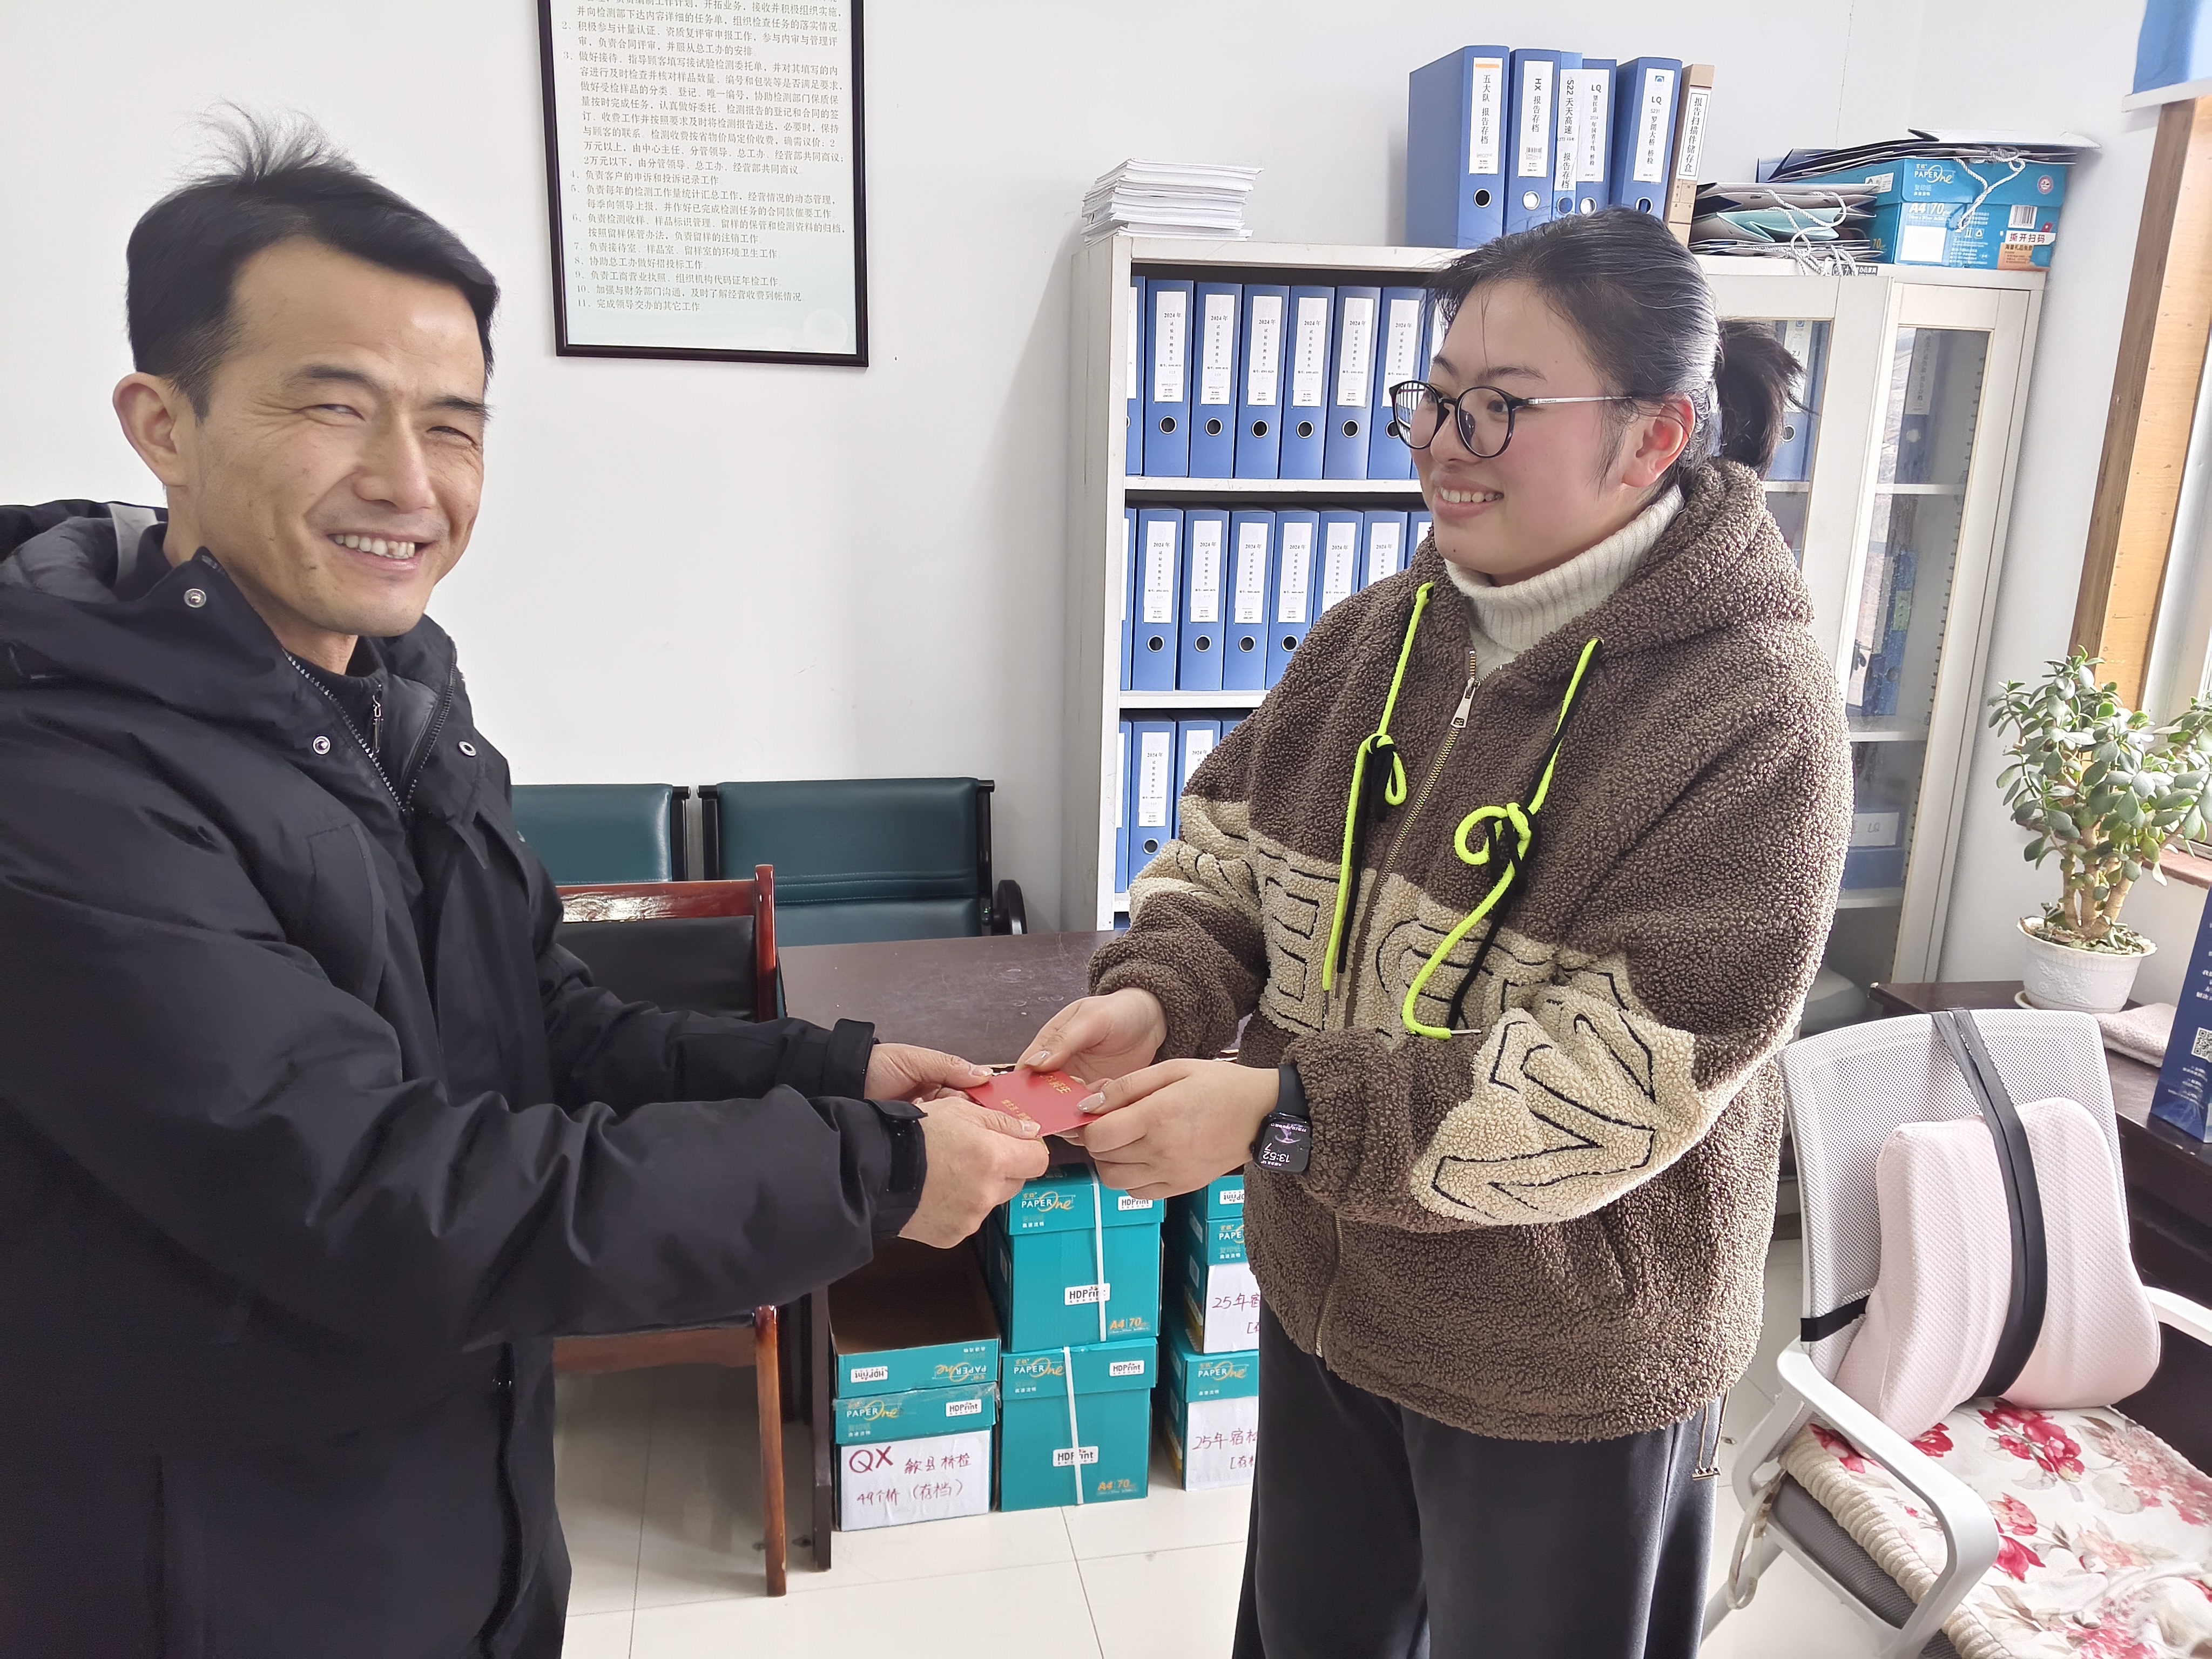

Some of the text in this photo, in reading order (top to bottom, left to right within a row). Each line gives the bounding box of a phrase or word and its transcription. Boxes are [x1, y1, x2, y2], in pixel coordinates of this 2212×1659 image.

[1482, 75, 1491, 103] 五大队
[1591, 84, 1601, 93] LQ
[1532, 78, 1542, 133] HX 报告存档
[1651, 96, 1662, 105] LQ
[1564, 98, 1574, 134] 天天高速
[1481, 107, 1489, 144] 报告存档
[1684, 97, 1703, 173] 报告扫描件储存盒
[1561, 152, 1571, 189] 报告存档
[1909, 203, 1944, 214] A4 70
[2009, 232, 2045, 243] 撕开扫码
[1264, 1143, 1272, 1151] 7
[1263, 1151, 1290, 1163] 13:52
[1121, 1198, 1149, 1206] HDPrint
[1109, 1317, 1142, 1330] A4 70
[1113, 1363, 1141, 1372] HDPrint
[855, 1370, 884, 1379] HDPrint
[949, 1402, 979, 1412] HDPrint
[849, 1446, 893, 1473] QX
[1057, 1452, 1093, 1461] HDPint
[1098, 1481, 1113, 1491] A4
